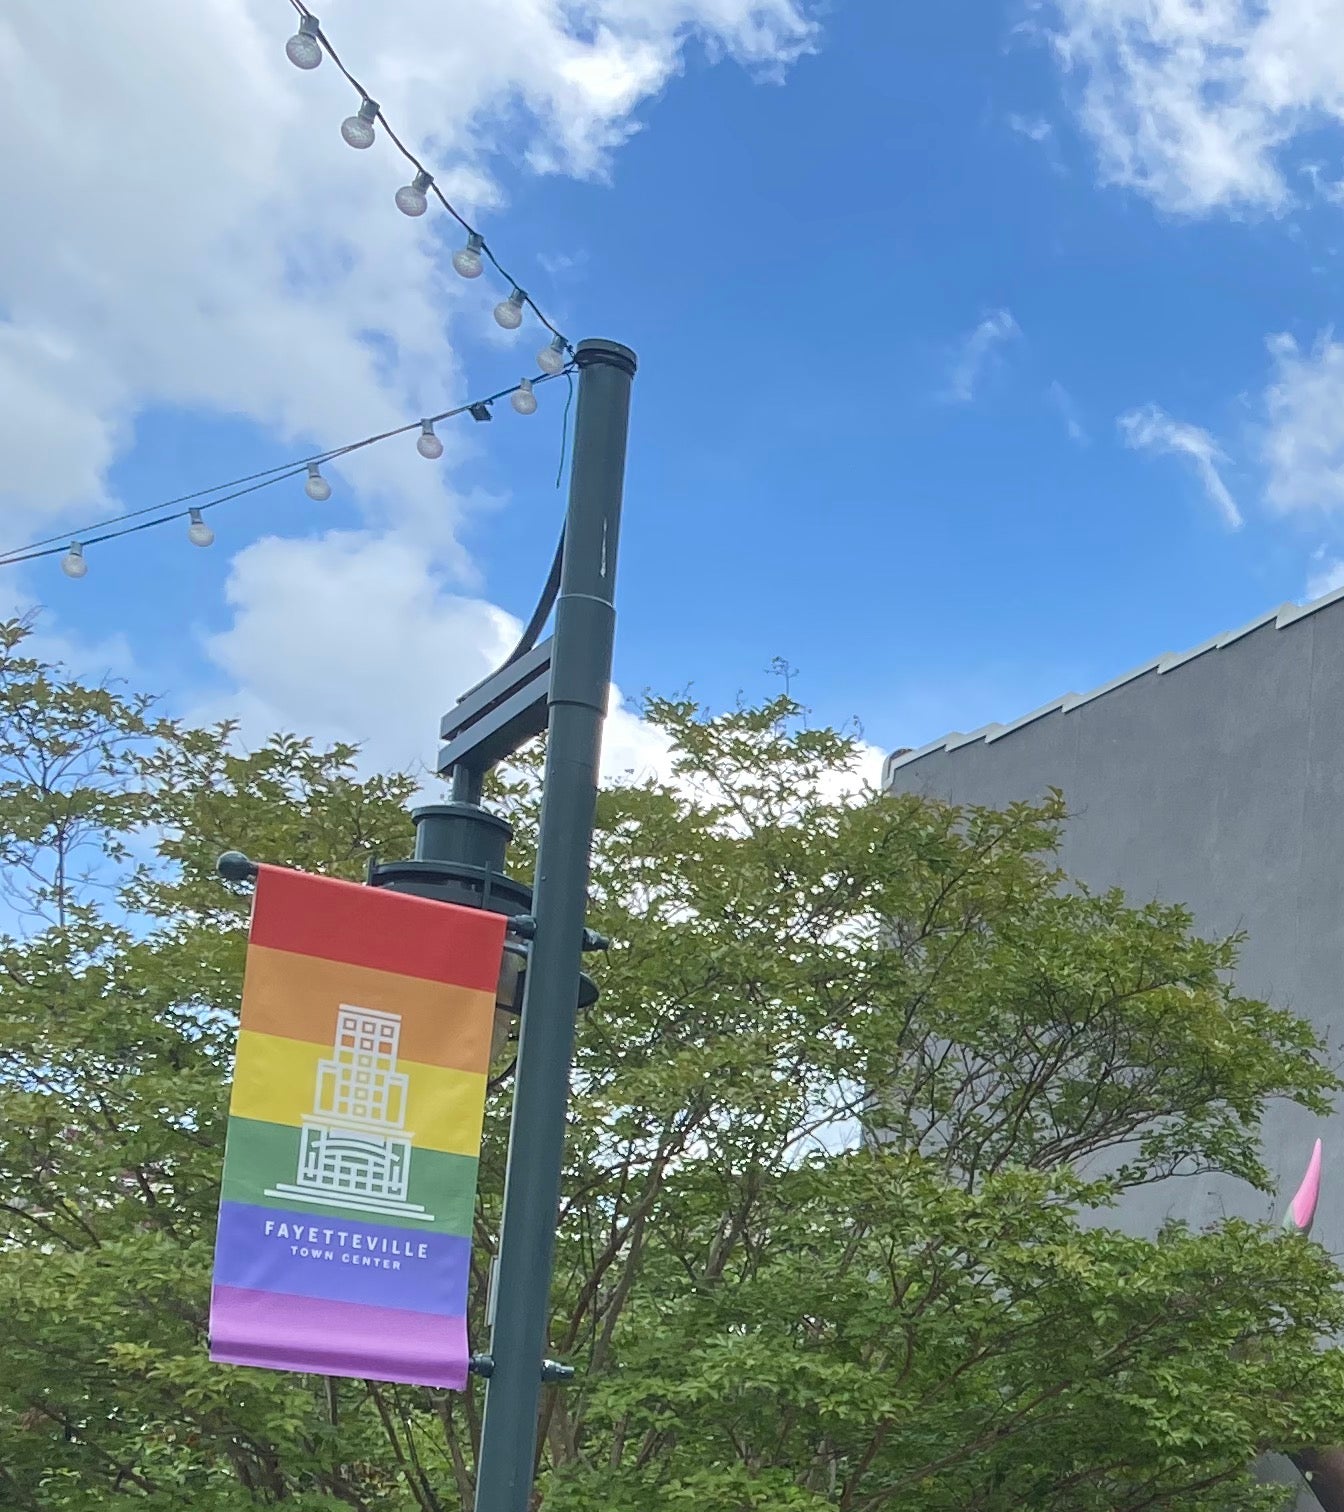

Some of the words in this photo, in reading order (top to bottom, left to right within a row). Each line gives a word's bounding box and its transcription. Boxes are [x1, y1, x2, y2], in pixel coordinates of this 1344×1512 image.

[265, 1221, 428, 1258] FAYETTEVILLE
[291, 1246, 333, 1260] TOWN
[342, 1254, 401, 1270] CENTER
